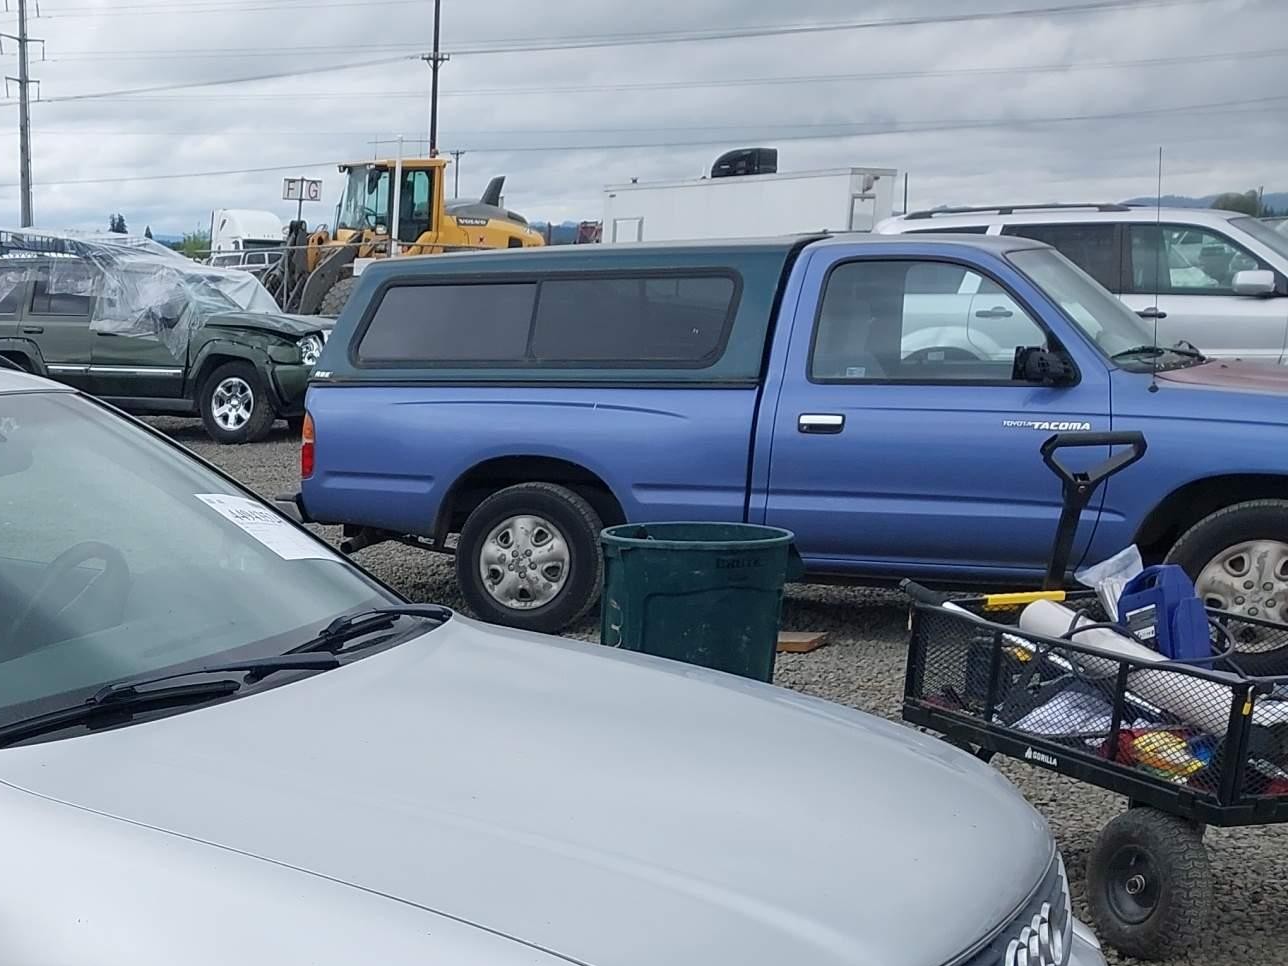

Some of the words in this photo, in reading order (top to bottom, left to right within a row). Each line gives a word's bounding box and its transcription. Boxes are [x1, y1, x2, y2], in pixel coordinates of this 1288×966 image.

[286, 179, 296, 197] F
[308, 180, 318, 200] G
[1032, 421, 1091, 430] TACOMA
[1032, 751, 1058, 767] GORILLA
